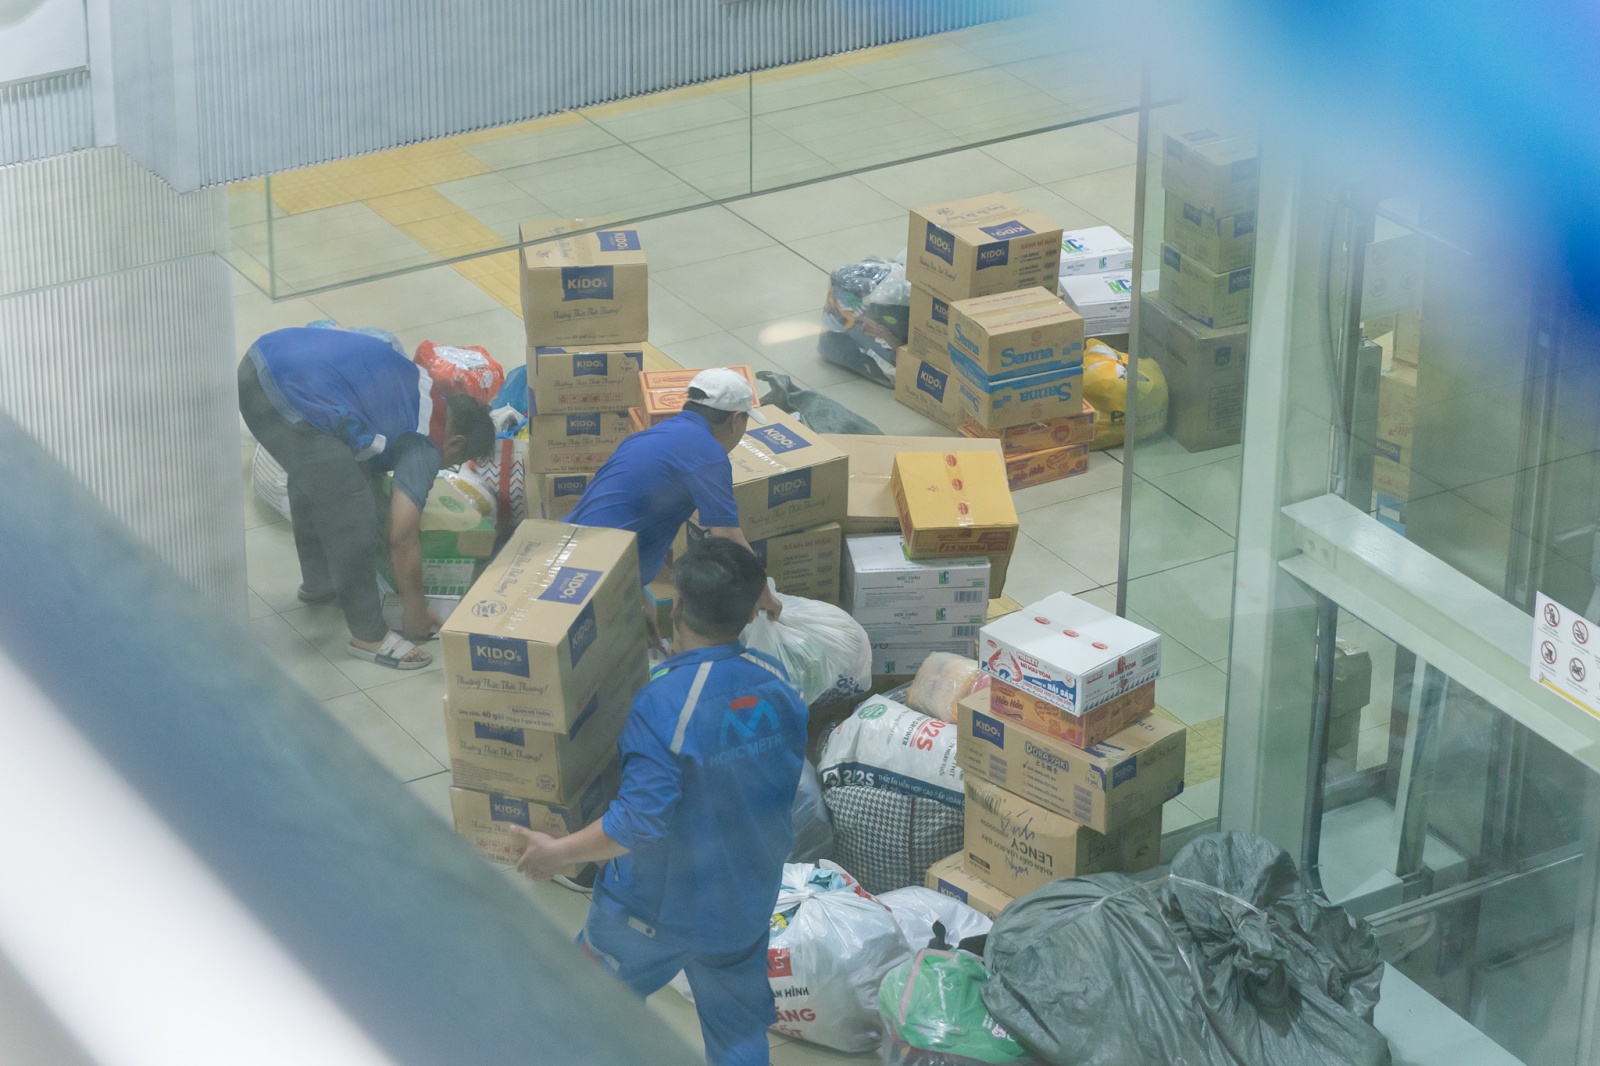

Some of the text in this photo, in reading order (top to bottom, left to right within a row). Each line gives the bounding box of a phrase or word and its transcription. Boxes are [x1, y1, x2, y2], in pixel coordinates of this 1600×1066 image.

[567, 277, 608, 290] KIDO's
[954, 322, 980, 356] Sanna
[1000, 346, 1054, 368] Sanna
[920, 370, 942, 390] KIDO's
[1019, 382, 1073, 403] Sanna
[763, 427, 797, 449] KIDO's
[773, 479, 808, 495] KIDO's
[559, 572, 589, 599] KIDO's
[476, 644, 522, 663] KIDO's
[995, 695, 1010, 707] Hảo
[1009, 699, 1024, 711] Hảo
[481, 710, 492, 719] 40
[975, 719, 1001, 738] KIDO's
[1010, 837, 1054, 868] LENCY
[784, 985, 810, 998] HÌNH
